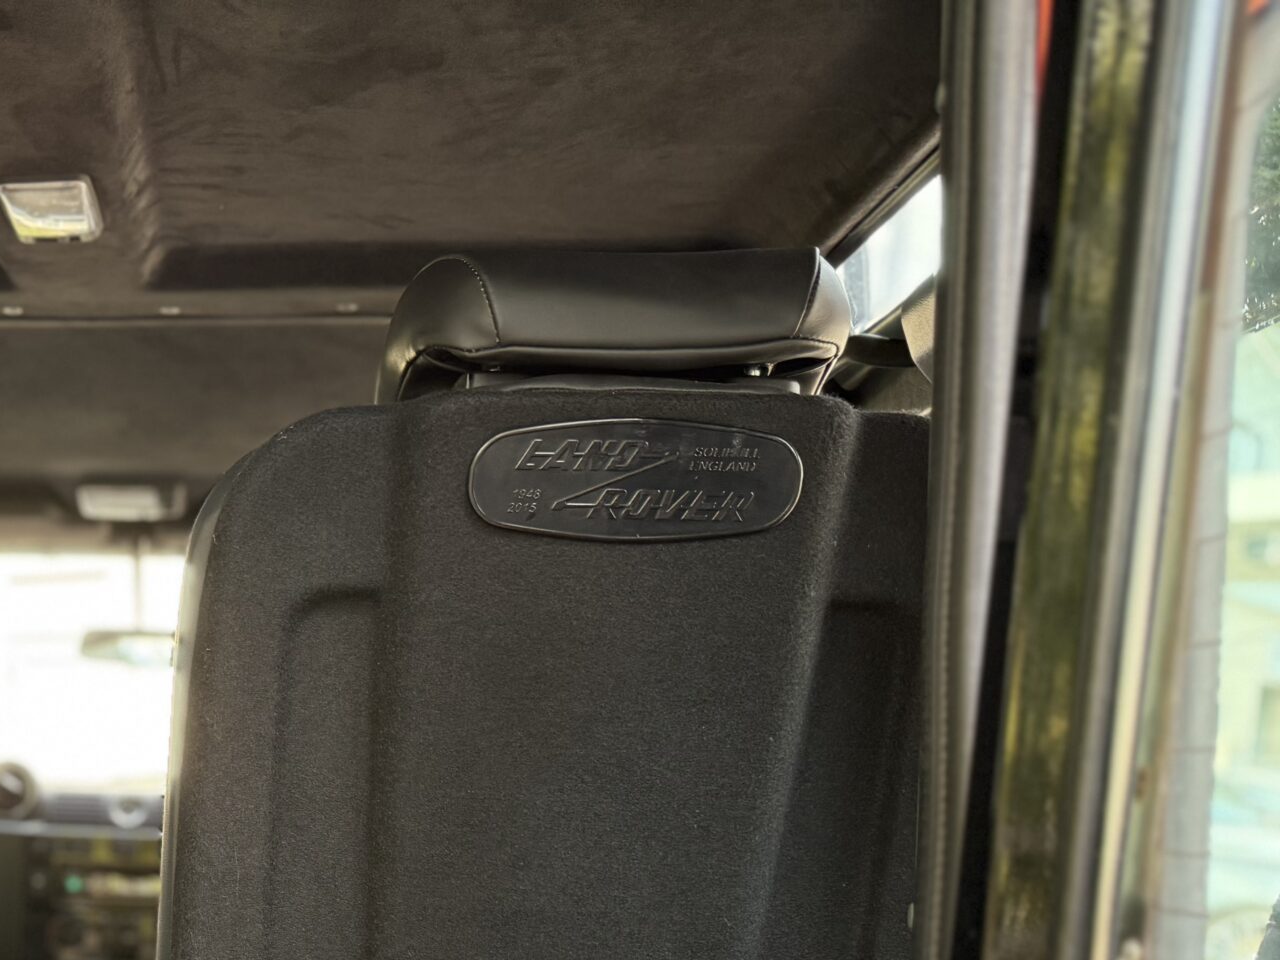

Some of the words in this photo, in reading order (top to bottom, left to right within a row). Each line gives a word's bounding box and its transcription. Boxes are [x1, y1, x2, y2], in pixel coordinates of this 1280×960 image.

[514, 438, 648, 471] LAND
[689, 460, 757, 472] ENGLAND
[506, 502, 538, 514] 2015
[585, 488, 755, 522] ROVER
